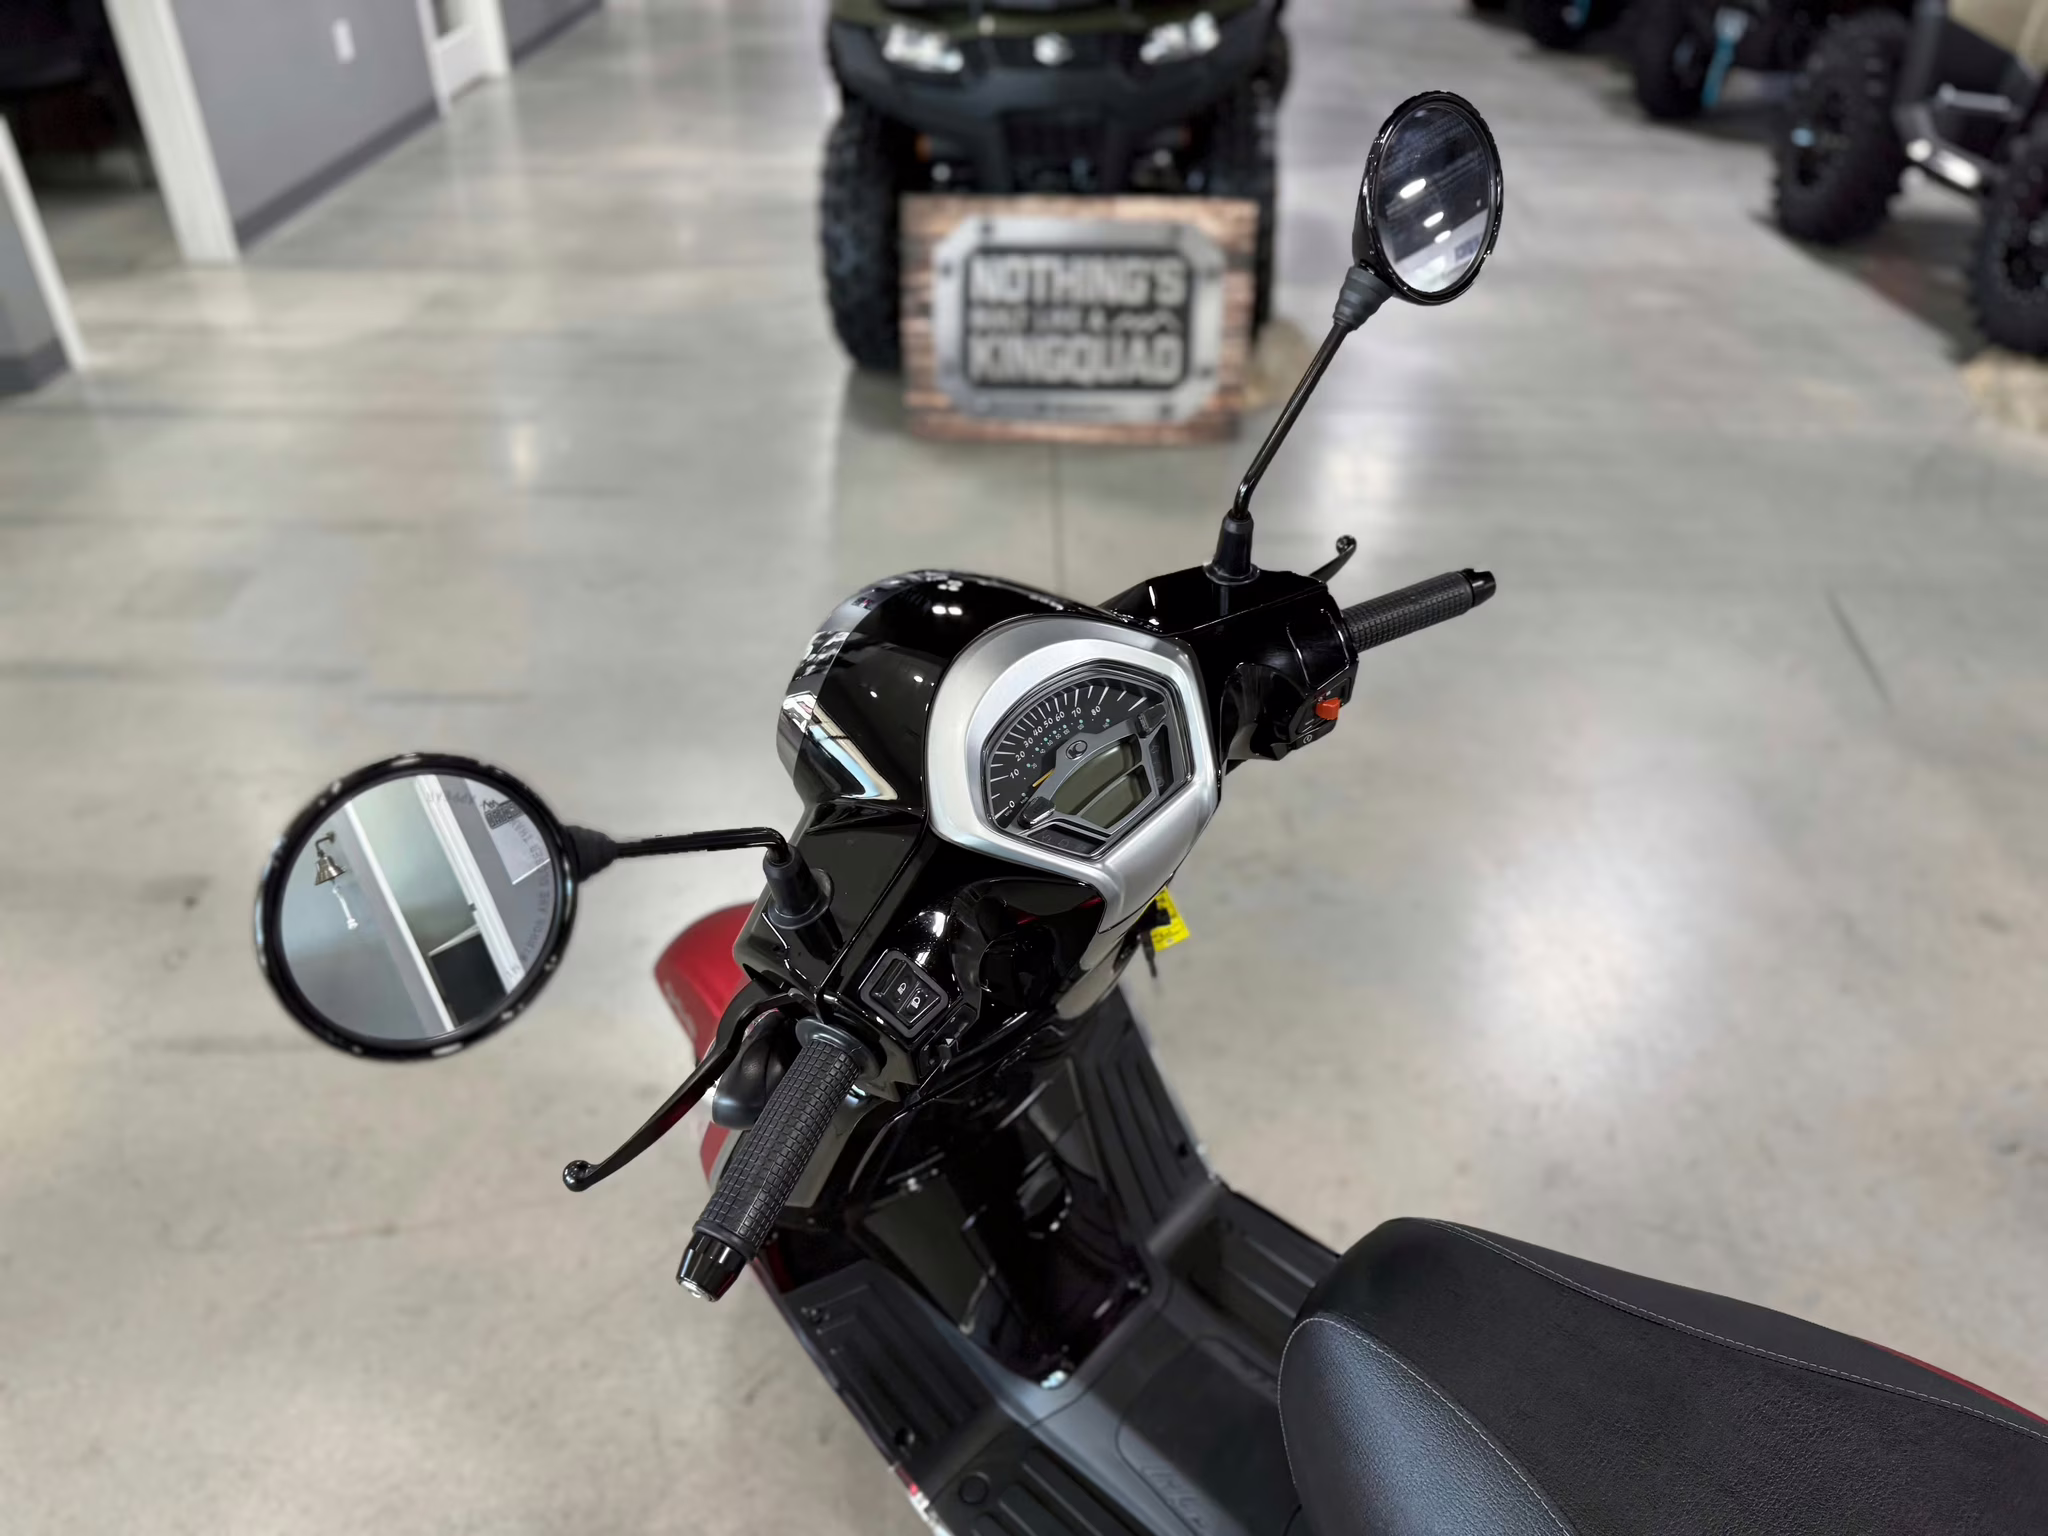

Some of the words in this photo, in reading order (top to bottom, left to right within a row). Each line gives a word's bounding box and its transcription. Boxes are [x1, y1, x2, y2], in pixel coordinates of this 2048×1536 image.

[969, 254, 1186, 306] NOTHING'S
[969, 334, 1185, 384] KINGQUAD
[1071, 707, 1081, 718] 70
[1091, 705, 1100, 716] 80
[1055, 711, 1065, 722] 60
[1043, 717, 1053, 728] 50
[1033, 726, 1043, 737] 40
[1023, 737, 1034, 749] 30
[1014, 750, 1025, 762] 20
[1010, 768, 1020, 779] 10
[1009, 800, 1015, 808] 0
